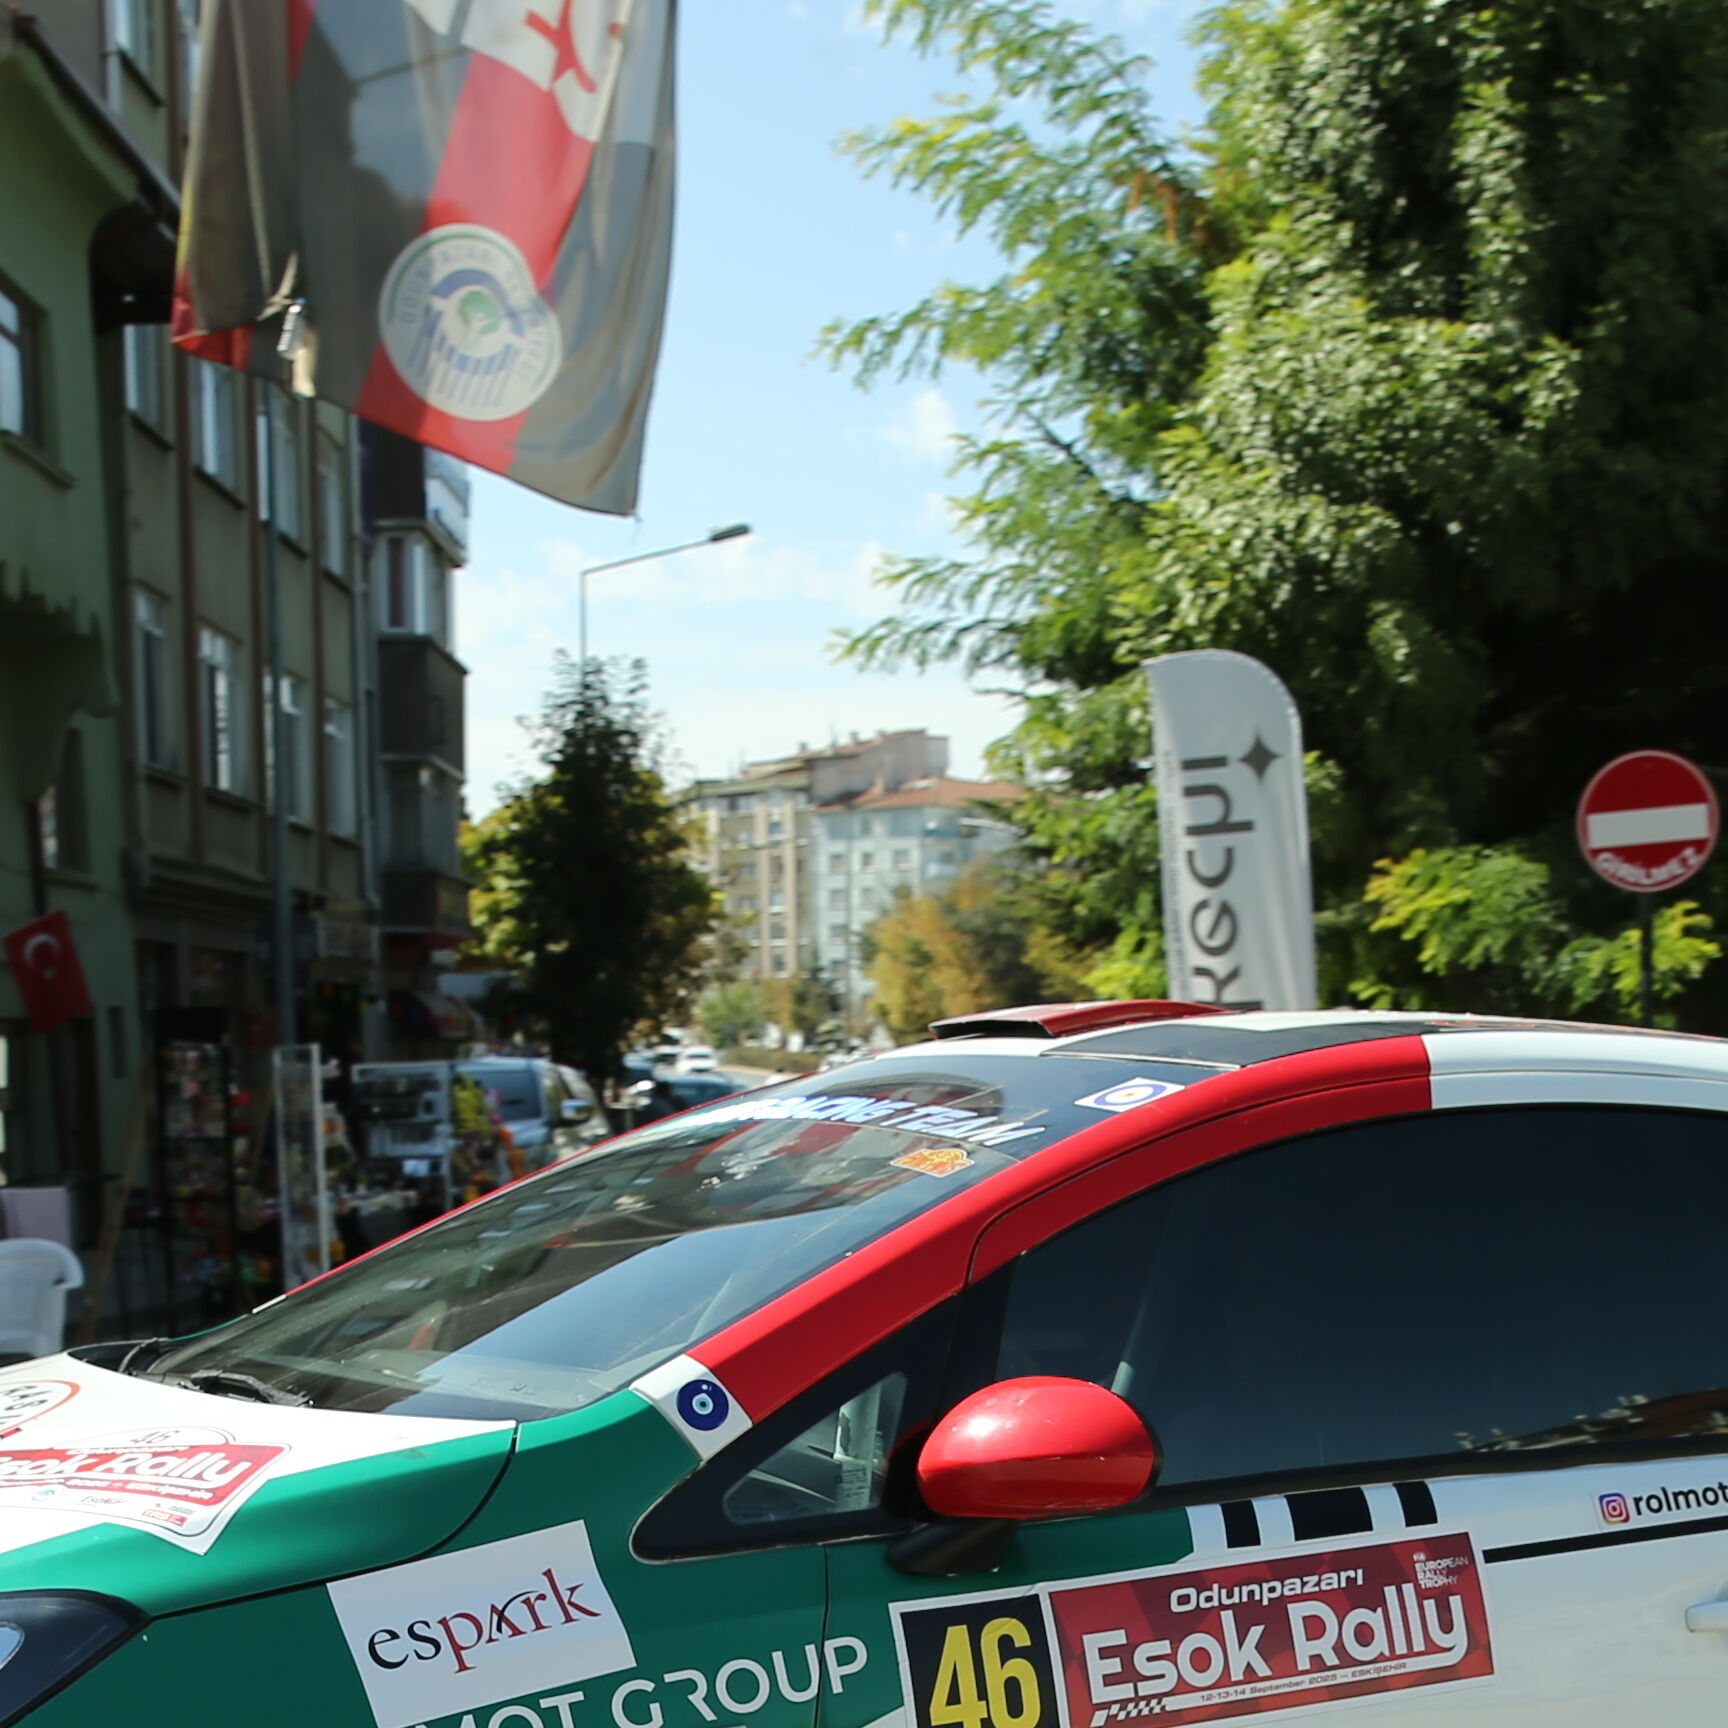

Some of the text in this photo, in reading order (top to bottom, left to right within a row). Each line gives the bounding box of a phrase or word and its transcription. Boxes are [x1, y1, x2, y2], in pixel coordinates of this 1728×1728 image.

[880, 1104, 1047, 1146] TEAM
[93, 1451, 252, 1488] Rally
[1414, 1555, 1470, 1572] EUROPEAN
[1170, 1568, 1365, 1614] Odunpazarı
[367, 1568, 603, 1674] espark
[1080, 1581, 1470, 1706] Esok Rally
[1249, 1679, 1305, 1697] September
